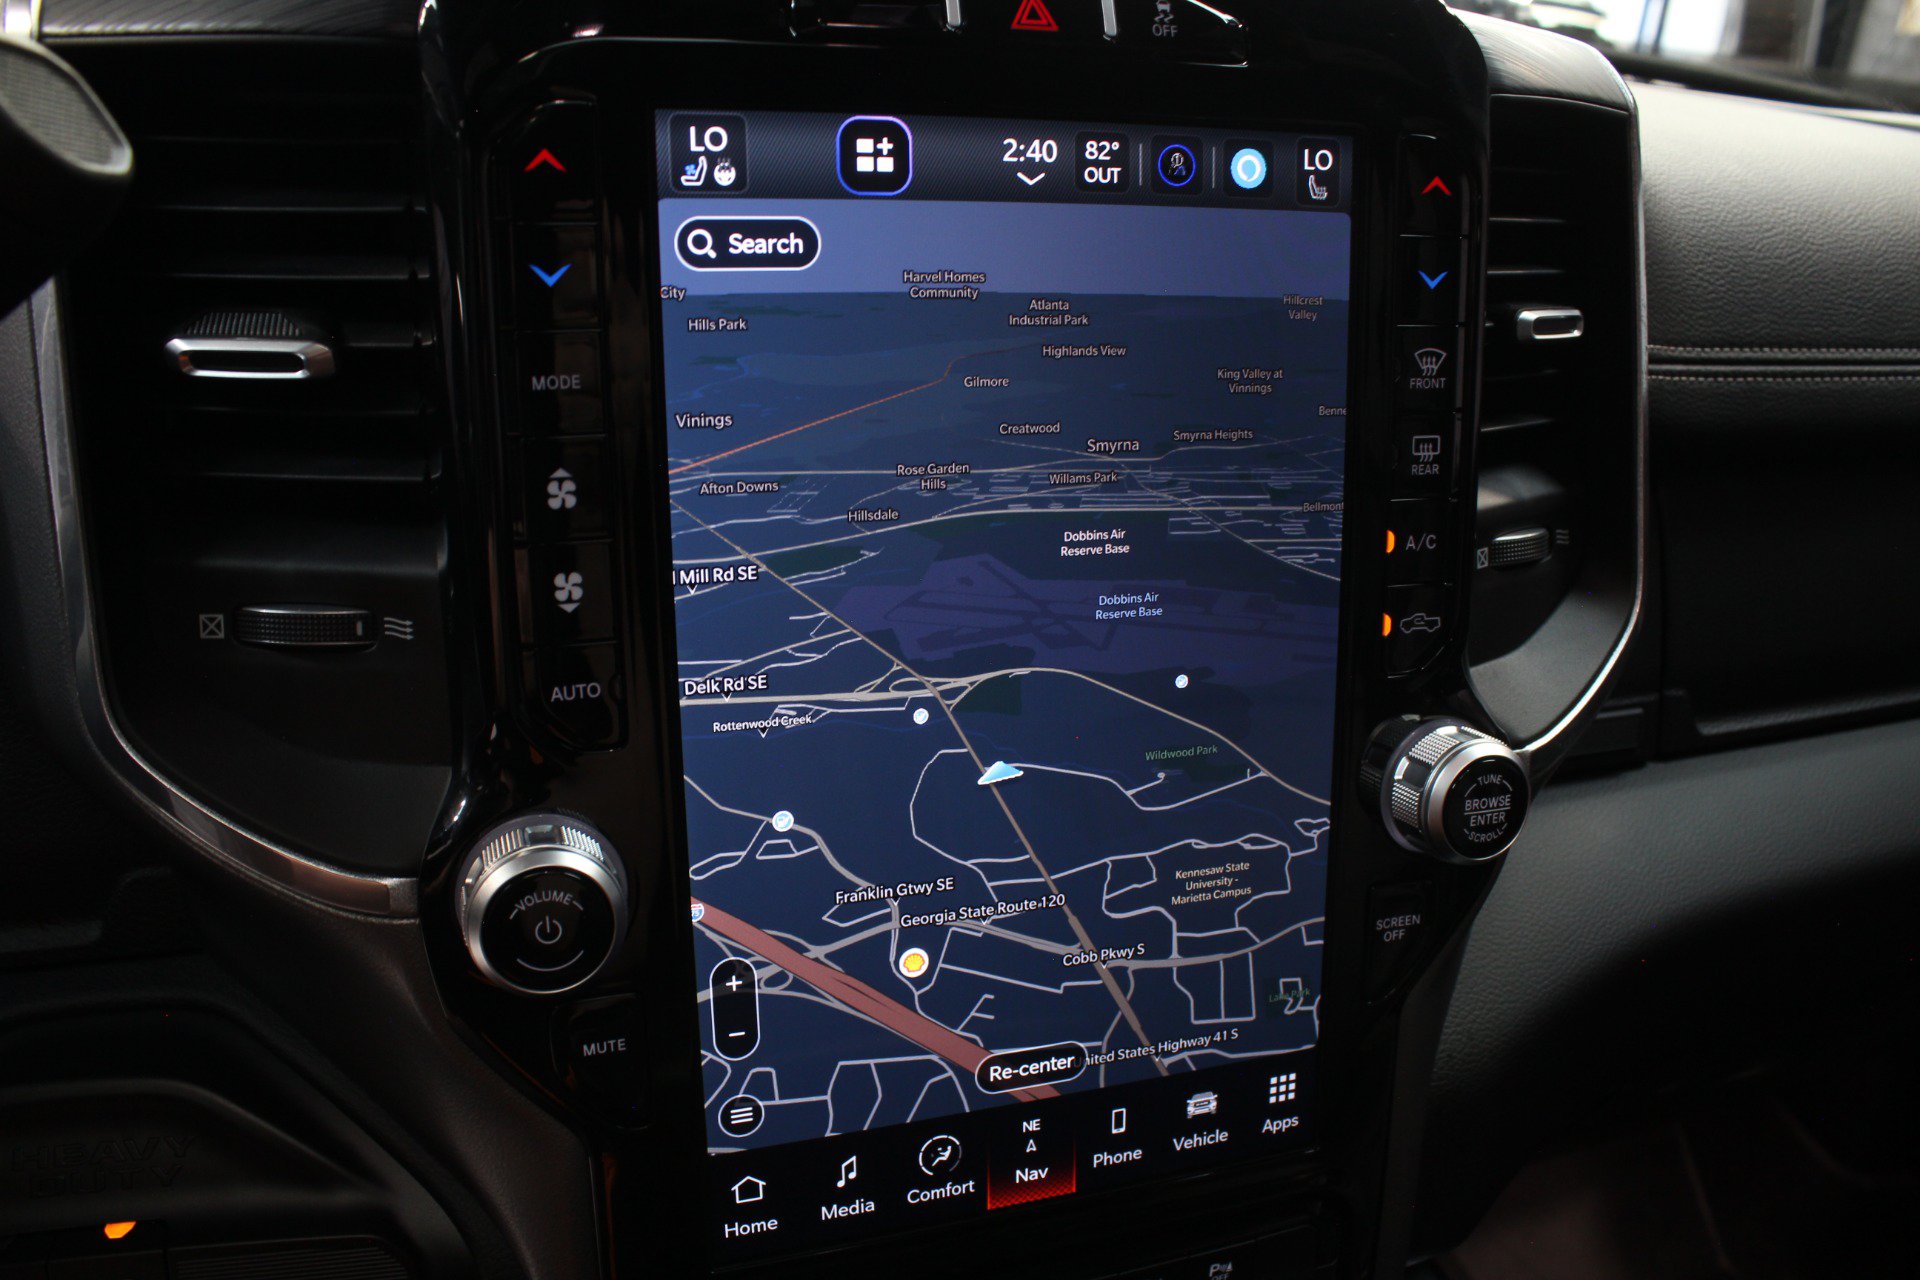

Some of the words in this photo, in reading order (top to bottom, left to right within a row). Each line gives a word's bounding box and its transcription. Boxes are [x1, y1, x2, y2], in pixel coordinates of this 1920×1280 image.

[1152, 24, 1178, 37] OFF
[690, 126, 728, 152] LO
[1003, 138, 1058, 162] 2:40
[1085, 140, 1120, 160] 82°
[1304, 148, 1333, 170] LO
[1084, 166, 1122, 184] OUT
[728, 232, 804, 254] Search
[903, 270, 942, 283] Harvel
[944, 271, 986, 283] Homes
[660, 286, 686, 301] City
[910, 286, 978, 300] Community
[1283, 294, 1323, 306] Hillcrest
[1030, 298, 1069, 311] Atlanta
[1009, 314, 1062, 326] Industrial
[1065, 314, 1088, 326] Park
[1288, 309, 1318, 322] Valley
[688, 319, 716, 330] Hills
[719, 318, 746, 330] Park
[1042, 345, 1098, 358] Highlands
[1100, 346, 1126, 356] View
[532, 374, 581, 390] MODE
[964, 376, 1010, 388] Gilmore
[1217, 368, 1240, 380] King
[1241, 368, 1270, 381] Valley
[1273, 369, 1284, 378] at
[1228, 383, 1272, 395] Vinnings
[1410, 378, 1446, 389] FRONT
[676, 413, 732, 430] Vinings
[1000, 422, 1061, 435] Creatwood
[1173, 430, 1212, 442] Smyrna
[1214, 428, 1253, 442] Heights
[1086, 438, 1140, 455] Smyrna
[897, 464, 925, 476] Rose
[928, 463, 970, 475] Garden
[1094, 472, 1118, 482] Park
[1412, 464, 1440, 476] REAR
[700, 482, 734, 495] Afton
[736, 480, 779, 493] Downs
[921, 478, 946, 490] Hills
[848, 508, 899, 522] Hillsdale
[1064, 530, 1108, 542] Dobbins
[1110, 529, 1126, 540] Air
[1406, 533, 1436, 551] A/C
[1060, 544, 1103, 558] Reserve
[1105, 543, 1130, 554] Base
[680, 568, 708, 584] Mill
[713, 566, 734, 582] Rd
[738, 566, 758, 580] SE
[1099, 593, 1142, 606] Dobbins
[1144, 592, 1160, 602] Air
[1096, 610, 1136, 620] Reserve
[1138, 606, 1163, 616] Base
[551, 682, 601, 702] AUTO
[684, 679, 720, 695] Delk
[724, 676, 745, 692] Rd
[748, 674, 768, 690] SE
[713, 718, 779, 733] Rottenwood
[781, 715, 812, 727] Creek
[1145, 748, 1194, 761] Wildwood
[1197, 745, 1218, 757] Park
[1478, 774, 1502, 786] TUNE
[1464, 794, 1511, 811] BROWSE
[1470, 812, 1506, 827] ENTER
[1468, 828, 1503, 842] SCROLL
[1176, 866, 1224, 880] Kennesaw
[1226, 862, 1250, 872] State
[836, 884, 894, 904] Franklin
[896, 881, 933, 900] Gtwy
[936, 878, 954, 892] SE
[1186, 876, 1234, 890] University
[516, 890, 573, 912] VOLUME
[1172, 892, 1212, 906] Marietta
[1214, 886, 1252, 899] Campus
[900, 908, 956, 928] Georgia
[958, 904, 994, 919] State
[998, 899, 1037, 916] Route
[1041, 894, 1066, 908] 120
[1376, 914, 1421, 930] SCREEN
[1384, 928, 1406, 942] OFF
[1063, 950, 1098, 967] Cobb
[1101, 945, 1136, 963] Pkwy
[1136, 943, 1145, 955] S
[582, 1038, 627, 1057] MUTE
[1118, 1045, 1156, 1060] States
[1158, 1036, 1212, 1052] Highway
[1213, 1031, 1228, 1042] 41
[1231, 1028, 1239, 1040] S
[989, 1055, 1076, 1082] Re-center
[1022, 1119, 1041, 1133] NE
[1262, 1115, 1299, 1134] Apps
[1172, 1129, 1229, 1151] Vehicle
[11, 1135, 197, 1171] HEAVY
[1093, 1149, 1143, 1168] Phone
[30, 1164, 185, 1198] DUTY
[1016, 1167, 1048, 1184] Nav
[907, 1180, 976, 1204] Comfort
[821, 1198, 875, 1220] Media
[724, 1218, 778, 1238] Home
